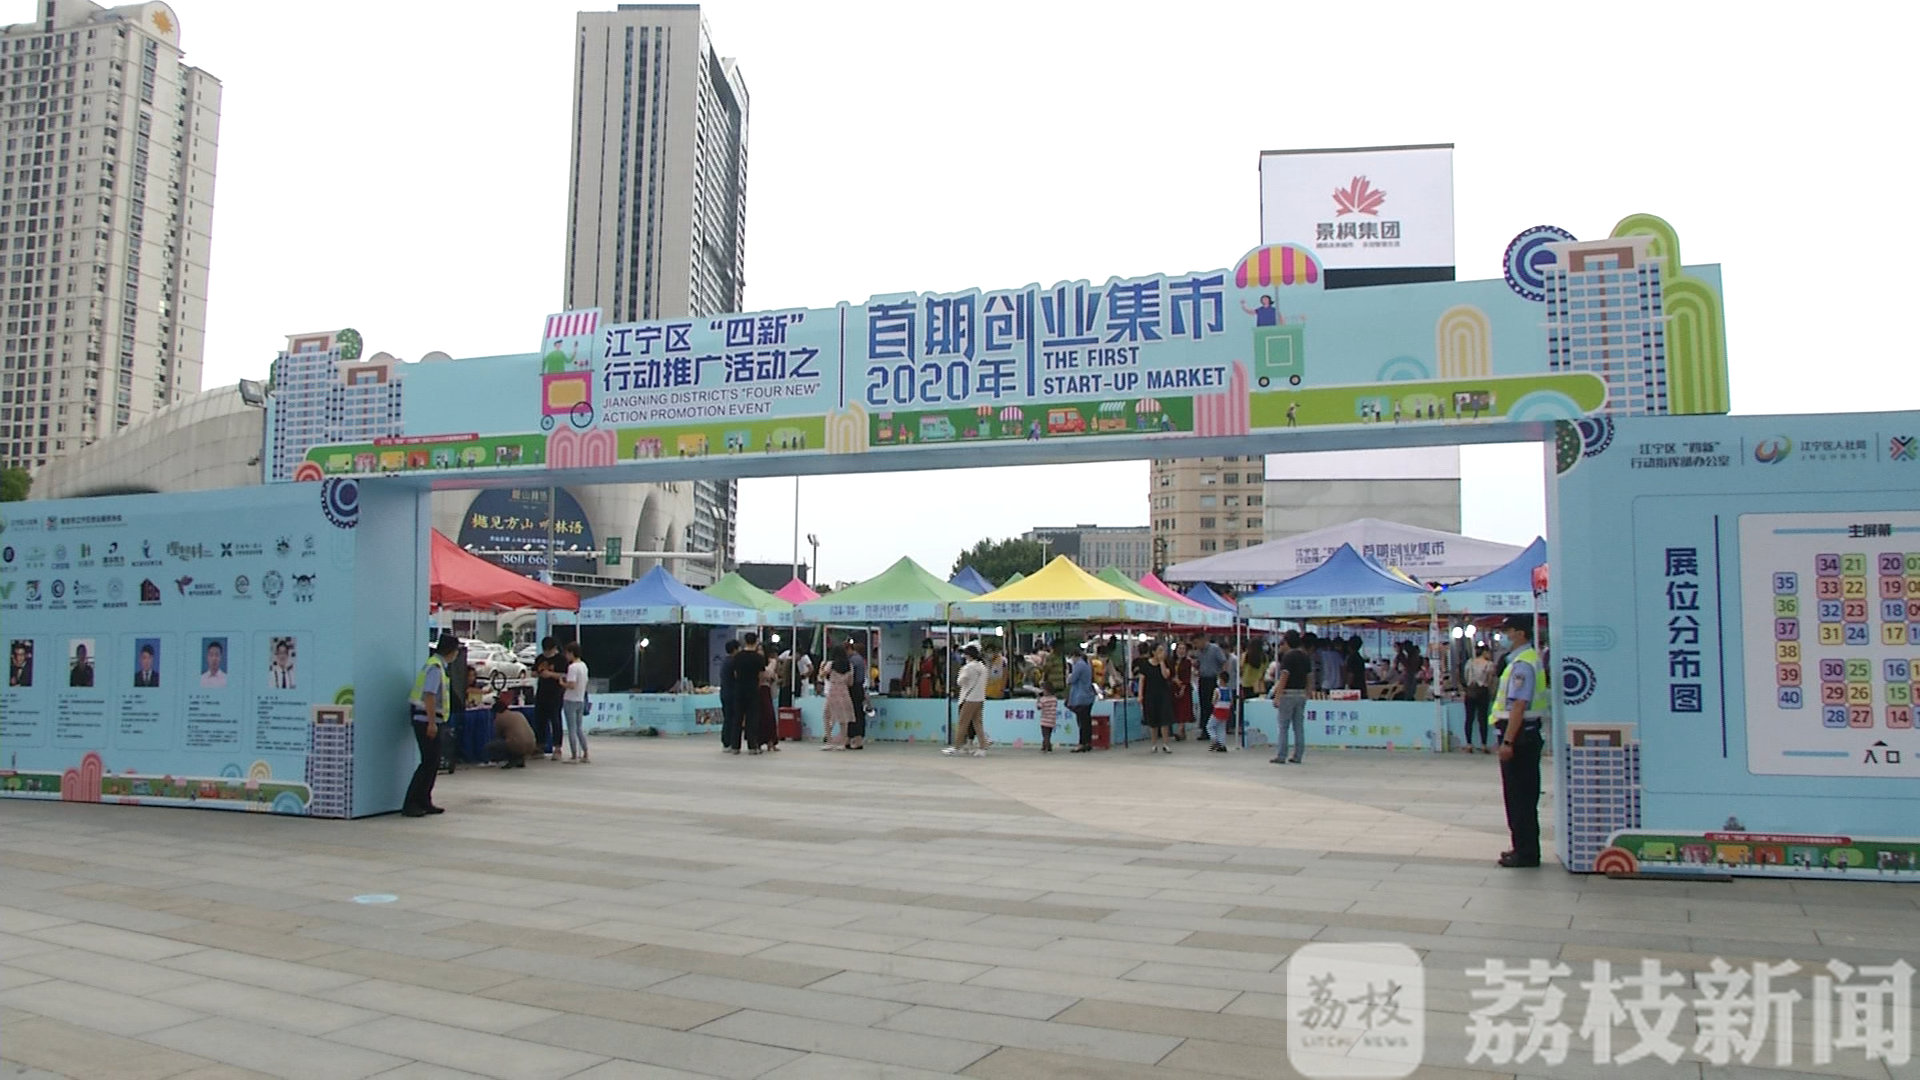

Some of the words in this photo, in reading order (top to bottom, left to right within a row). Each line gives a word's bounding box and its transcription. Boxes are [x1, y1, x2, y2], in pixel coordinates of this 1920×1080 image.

[1316, 221, 1400, 240] 景枫集团
[867, 274, 1225, 397] 首期创业集市
[1043, 351, 1078, 370] THE
[1087, 346, 1140, 367] FIRST
[603, 347, 820, 392] 行动推广活动之
[866, 358, 1017, 406] 2020年
[1043, 372, 1139, 395] START-UP
[1147, 367, 1226, 390] MARKET
[602, 393, 669, 410] JIANGNING
[601, 408, 649, 424] ACTION
[650, 405, 728, 421] PROMOTION
[729, 402, 772, 417] EVENT
[1849, 524, 1892, 538] 主屏幕
[1820, 558, 1838, 571] 34
[1845, 558, 1861, 571] 21
[1882, 557, 1900, 570] 20
[1776, 576, 1794, 590] 35
[1821, 581, 1838, 594] 33
[1845, 581, 1863, 594] 22
[1884, 581, 1901, 593] 19
[1777, 599, 1796, 613] 36
[1821, 604, 1840, 617] 32
[1846, 604, 1864, 617] 23
[1885, 604, 1903, 616] 18
[1665, 548, 1702, 713] 展位分布图
[1778, 622, 1796, 635] 37
[1822, 627, 1839, 640] 31
[1847, 627, 1866, 640] 24
[1886, 627, 1903, 640] 17
[1779, 645, 1797, 659] 38
[1780, 668, 1799, 681] 39
[1824, 663, 1843, 676] 30
[1849, 664, 1867, 676] 25
[1888, 663, 1906, 676] 16
[1781, 691, 1800, 704] 40
[1826, 686, 1844, 700] 29
[1850, 687, 1869, 700] 26
[1889, 687, 1907, 700] 15
[1827, 710, 1846, 723] 28
[1852, 710, 1870, 723] 27
[1891, 710, 1909, 723] 14
[1863, 749, 1900, 764] 入口
